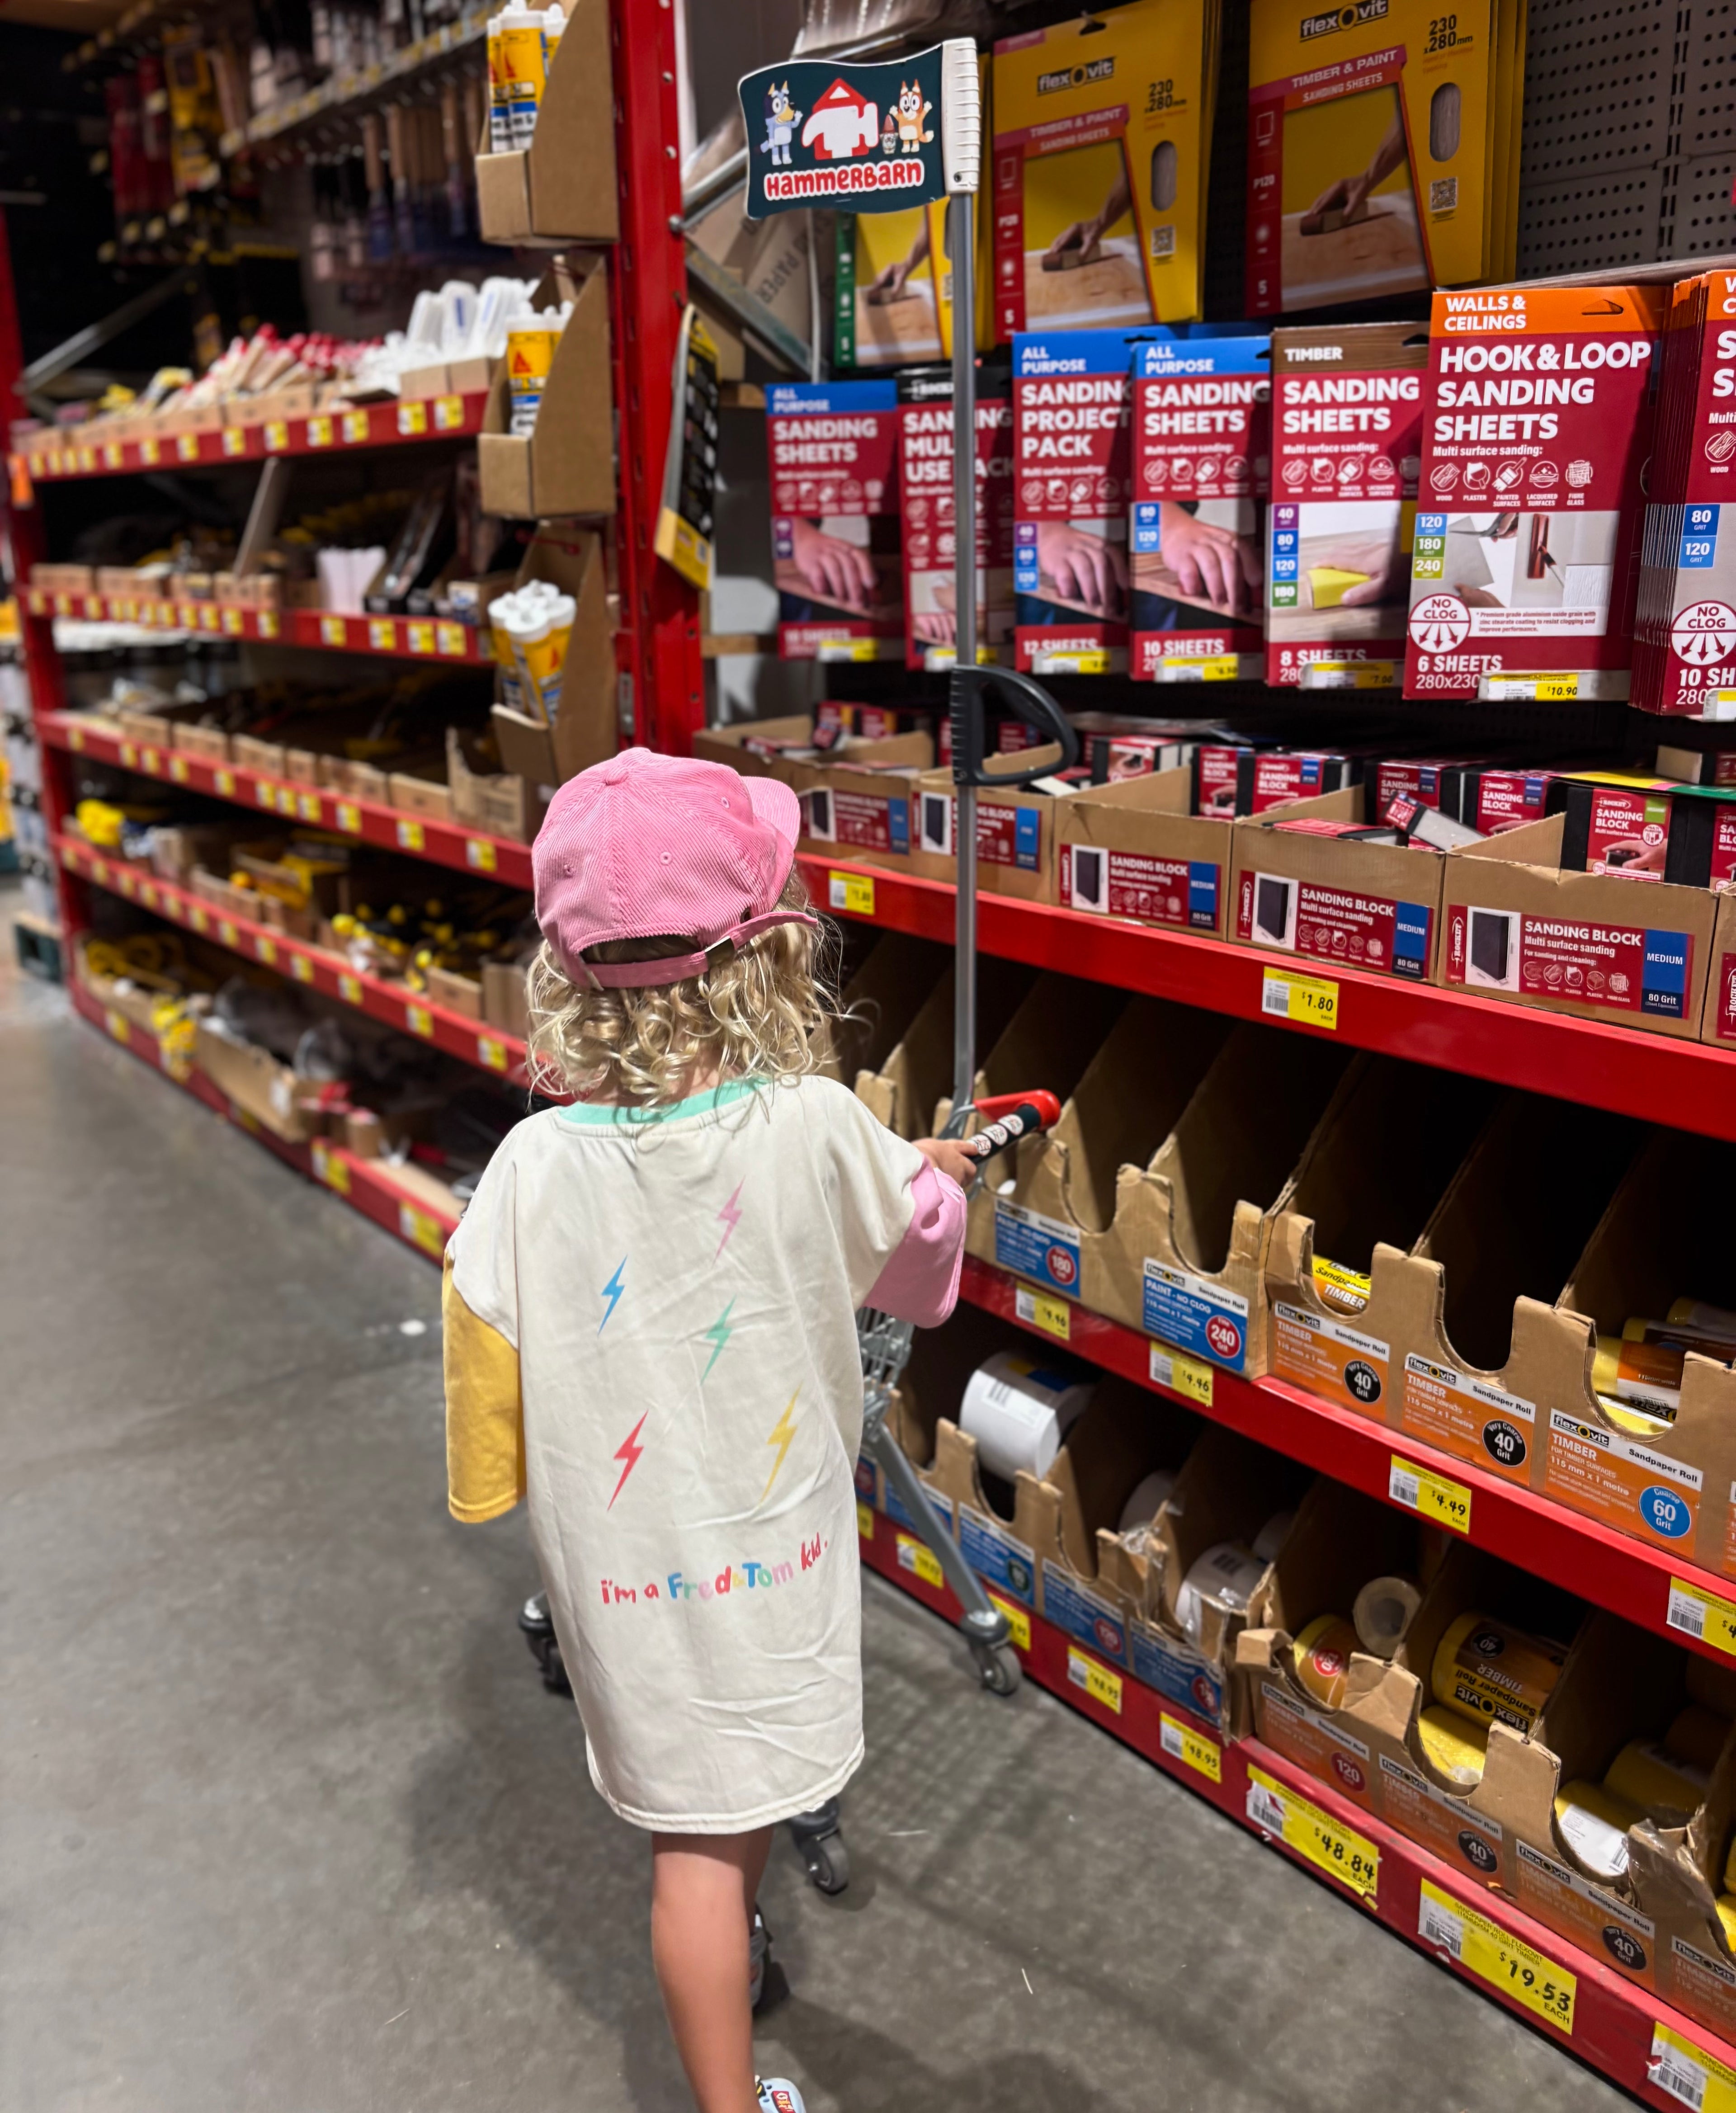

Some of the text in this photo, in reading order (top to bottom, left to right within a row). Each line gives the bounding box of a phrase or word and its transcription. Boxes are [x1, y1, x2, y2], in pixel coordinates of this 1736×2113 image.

[1429, 15, 1457, 36] 230
[1292, 67, 1340, 89] TIMBER
[1357, 50, 1397, 70] PAINT
[1149, 80, 1173, 97] 230
[1303, 72, 1382, 103] SANDING SHEETS
[1030, 115, 1073, 138] TIMBER
[1085, 107, 1123, 126] PAINT
[1446, 296, 1526, 312] WALLS &
[1444, 314, 1527, 332] CEILINGS
[1022, 347, 1049, 361] ALL
[1145, 346, 1174, 360] ALL
[1284, 347, 1343, 362] TIMBER
[1022, 359, 1086, 374] PURPOSE
[1145, 359, 1214, 375] PURPOSE
[774, 388, 797, 401] ALL
[1144, 380, 1271, 407] SANDING
[1283, 377, 1420, 405] SANDING
[1437, 377, 1594, 407] SANDING
[774, 418, 878, 442] SANDING
[1144, 410, 1245, 435] SHEETS
[1283, 408, 1391, 434] SHEETS
[1434, 413, 1558, 441] SHEETS
[775, 442, 857, 465] SHEETS
[1022, 434, 1093, 459] PACK
[1283, 443, 1379, 454] Multi surface sanding:
[1433, 445, 1543, 457] Multi surface sanding:
[906, 459, 952, 483] USE
[1278, 508, 1294, 519] 40
[1420, 516, 1443, 528] 120
[1691, 510, 1712, 523] 80
[1138, 531, 1156, 542] 120
[1277, 534, 1294, 546] 80
[1419, 538, 1441, 550] 180
[1685, 542, 1710, 555] 120
[1275, 560, 1295, 571] 120
[1415, 560, 1440, 571] 240
[1274, 586, 1294, 597] 180
[1431, 599, 1451, 608] NO
[1697, 607, 1719, 617] NO
[1423, 609, 1458, 619] CLOG
[1688, 618, 1726, 628] CLOG
[1143, 638, 1224, 656] 10 SHEETS
[1280, 650, 1293, 666] 8
[1418, 655, 1502, 672] 6 SHEETS
[1679, 669, 1701, 686] 10
[1258, 780, 1288, 790] BLOCK
[1259, 772, 1300, 783] SANDING
[1381, 780, 1418, 791] SANDING
[1482, 791, 1523, 804] SANDING
[1482, 800, 1511, 810] BLOCK
[1595, 818, 1629, 830] BLOCK
[1596, 808, 1643, 822] SANDING
[1110, 855, 1188, 877] SANDING BLOCK
[1190, 880, 1216, 891] MEDIUM
[1301, 888, 1394, 917] SANDING BLOCK
[1301, 901, 1373, 926] Multi surface sanding
[1396, 923, 1425, 935] MEDIUM
[1525, 921, 1642, 946] SANDING BLOCK
[1524, 936, 1615, 958] Multi surface sanding
[1646, 953, 1683, 965] MEDIUM
[1302, 991, 1334, 1012] $1.80
[1648, 993, 1676, 1005] 80 Grit
[1051, 1254, 1072, 1274] 180
[1325, 1283, 1365, 1310] TIMBER
[1211, 1325, 1235, 1347] 240
[1277, 1320, 1312, 1342] TIMBER
[1335, 1329, 1371, 1349] Sandpaper
[1354, 1372, 1372, 1390] 40
[1407, 1374, 1446, 1398] TIMBER
[1472, 1385, 1514, 1407] Sandpaper
[1515, 1403, 1531, 1415] Roll
[1494, 1432, 1514, 1453] 40
[1552, 1433, 1597, 1461] TIMBER
[1497, 1448, 1510, 1461] Grit
[1551, 1456, 1585, 1476] 115 mm
[1628, 1448, 1677, 1474] Sandpaper
[1679, 1469, 1697, 1483] Roll
[1431, 1490, 1466, 1516] $4.49
[1653, 1499, 1676, 1522] 60
[1452, 1517, 1466, 1527] EACH
[1656, 1517, 1672, 1531] Grit
[600, 1580, 636, 1604] i'm
[644, 1583, 659, 1599] a
[742, 1561, 794, 1589] Tom
[1477, 1663, 1523, 1695] TIMBER
[1456, 1669, 1536, 1717] Sandpaper Roll
[1336, 1759, 1359, 1783] 120
[1314, 1827, 1375, 1881] $48.84
[1468, 1841, 1486, 1860] 40
[1352, 1872, 1375, 1892] EACH
[1454, 1901, 1543, 1963] SANDPAPER ROLL FLEXOVIT
[1499, 1936, 1514, 1950] GRIT
[1515, 1948, 1541, 1967] TIMBER
[1614, 1937, 1634, 1957] 40
[1499, 1951, 1571, 2012] $19.53
[1543, 2002, 1570, 2024] EACH
